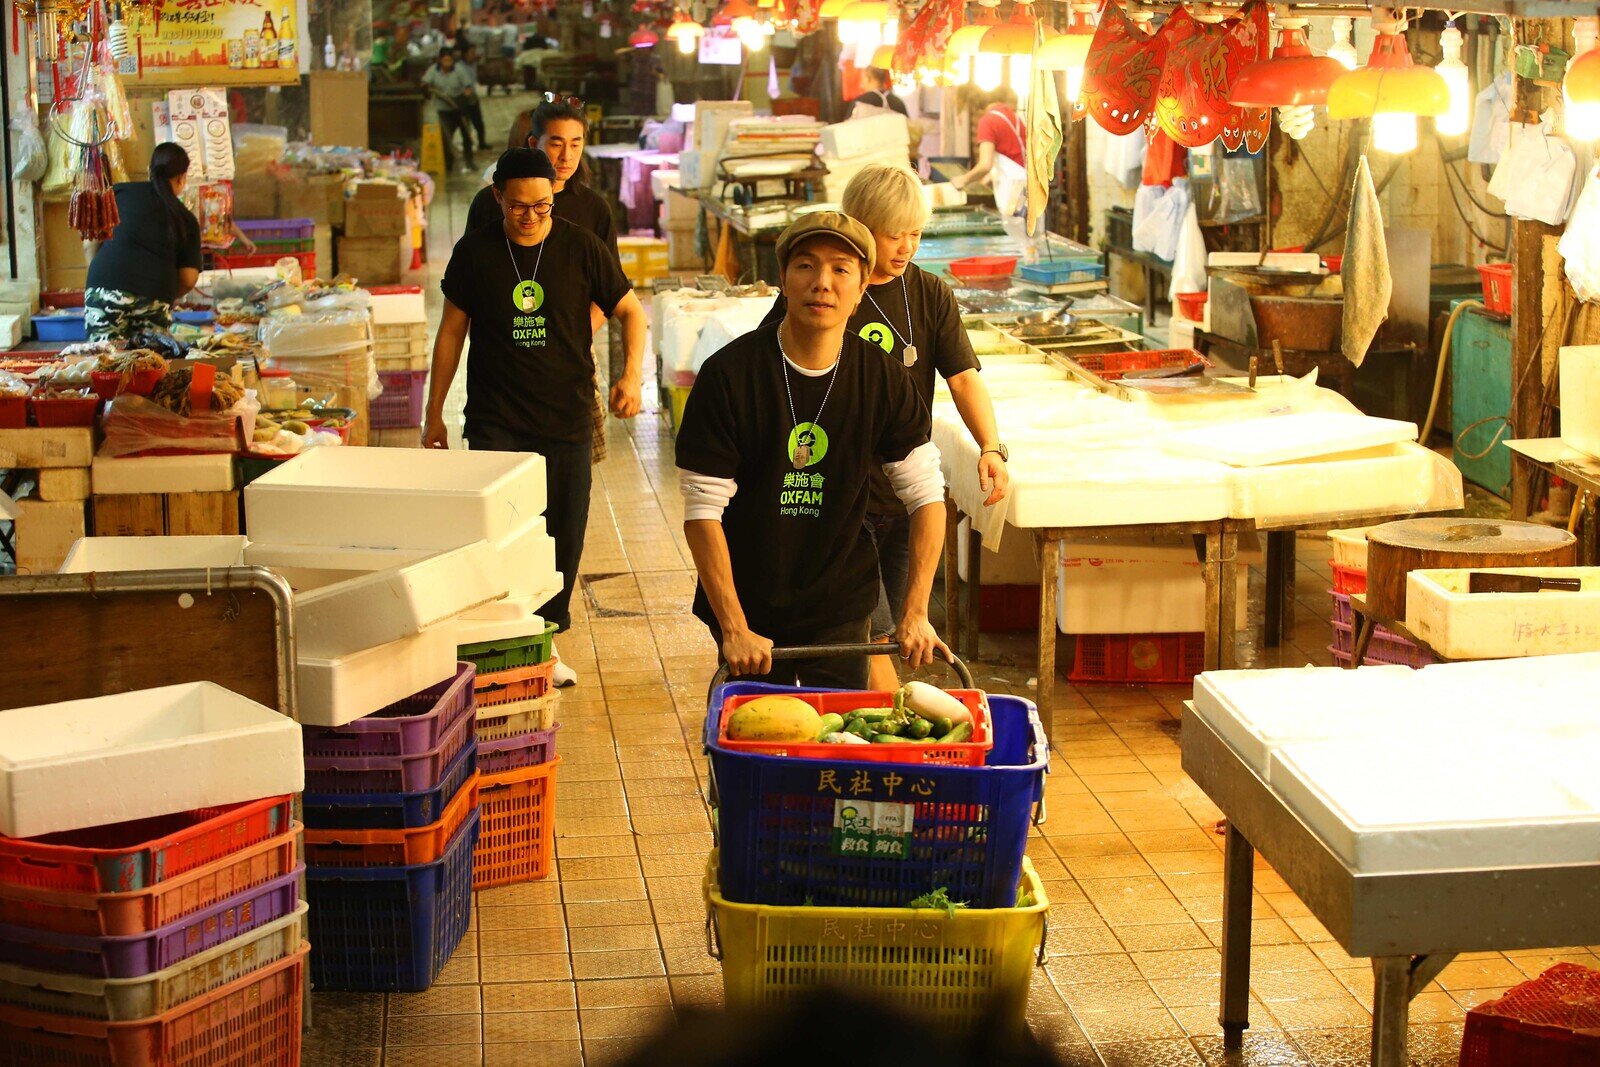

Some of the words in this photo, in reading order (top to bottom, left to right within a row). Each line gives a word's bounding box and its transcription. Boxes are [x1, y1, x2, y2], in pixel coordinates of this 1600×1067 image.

[513, 315, 546, 328] 樂施會
[512, 328, 546, 340] OXFAM
[530, 339, 546, 347] Kong
[783, 471, 826, 489] 樂施會
[780, 490, 823, 505] OXFAM
[780, 506, 798, 516] Hong
[799, 506, 820, 518] Kong
[818, 769, 936, 797] 民社中心
[822, 917, 938, 942] 民社中心
